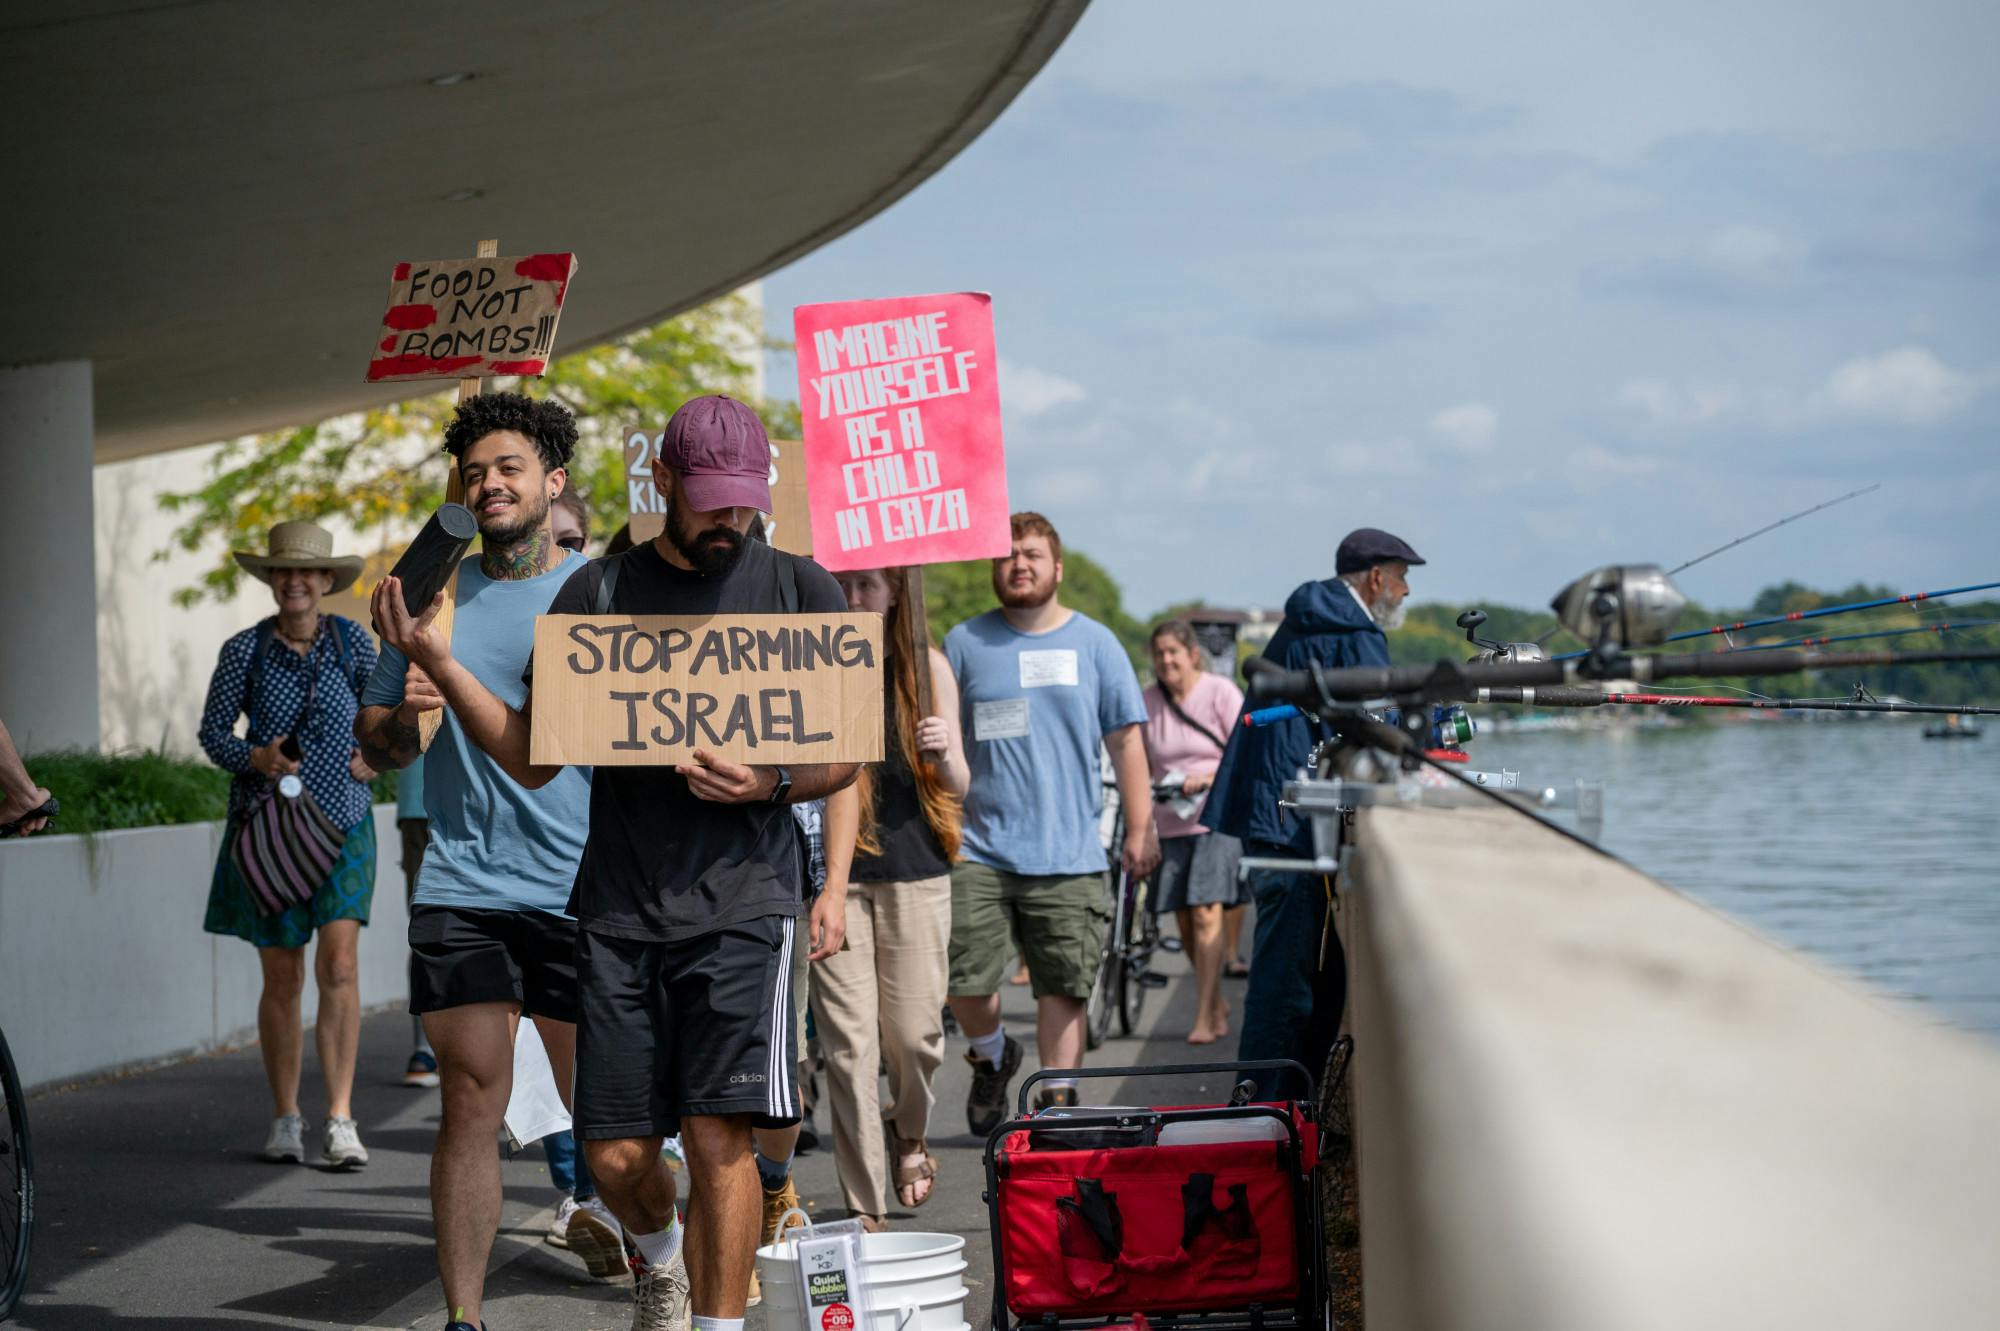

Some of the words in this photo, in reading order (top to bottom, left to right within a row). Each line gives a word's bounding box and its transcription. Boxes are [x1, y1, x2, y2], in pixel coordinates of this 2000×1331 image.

[408, 267, 496, 303] FOOD
[450, 285, 533, 324] NOT
[400, 315, 555, 362] BOMBS!!!
[813, 311, 953, 373] IMAGINE
[810, 350, 978, 420] YOURSELF
[844, 411, 894, 459] AS
[898, 405, 925, 450] A
[841, 450, 942, 505] CHILD
[835, 505, 873, 552] IN
[878, 488, 970, 543] GAZA
[567, 623, 693, 675] STOP
[689, 624, 875, 675] ARMING
[608, 688, 834, 750] ISRAEL
[729, 1073, 767, 1084] adidas
[810, 1283, 847, 1295] Bubbles
[812, 1274, 841, 1287] Quiet
